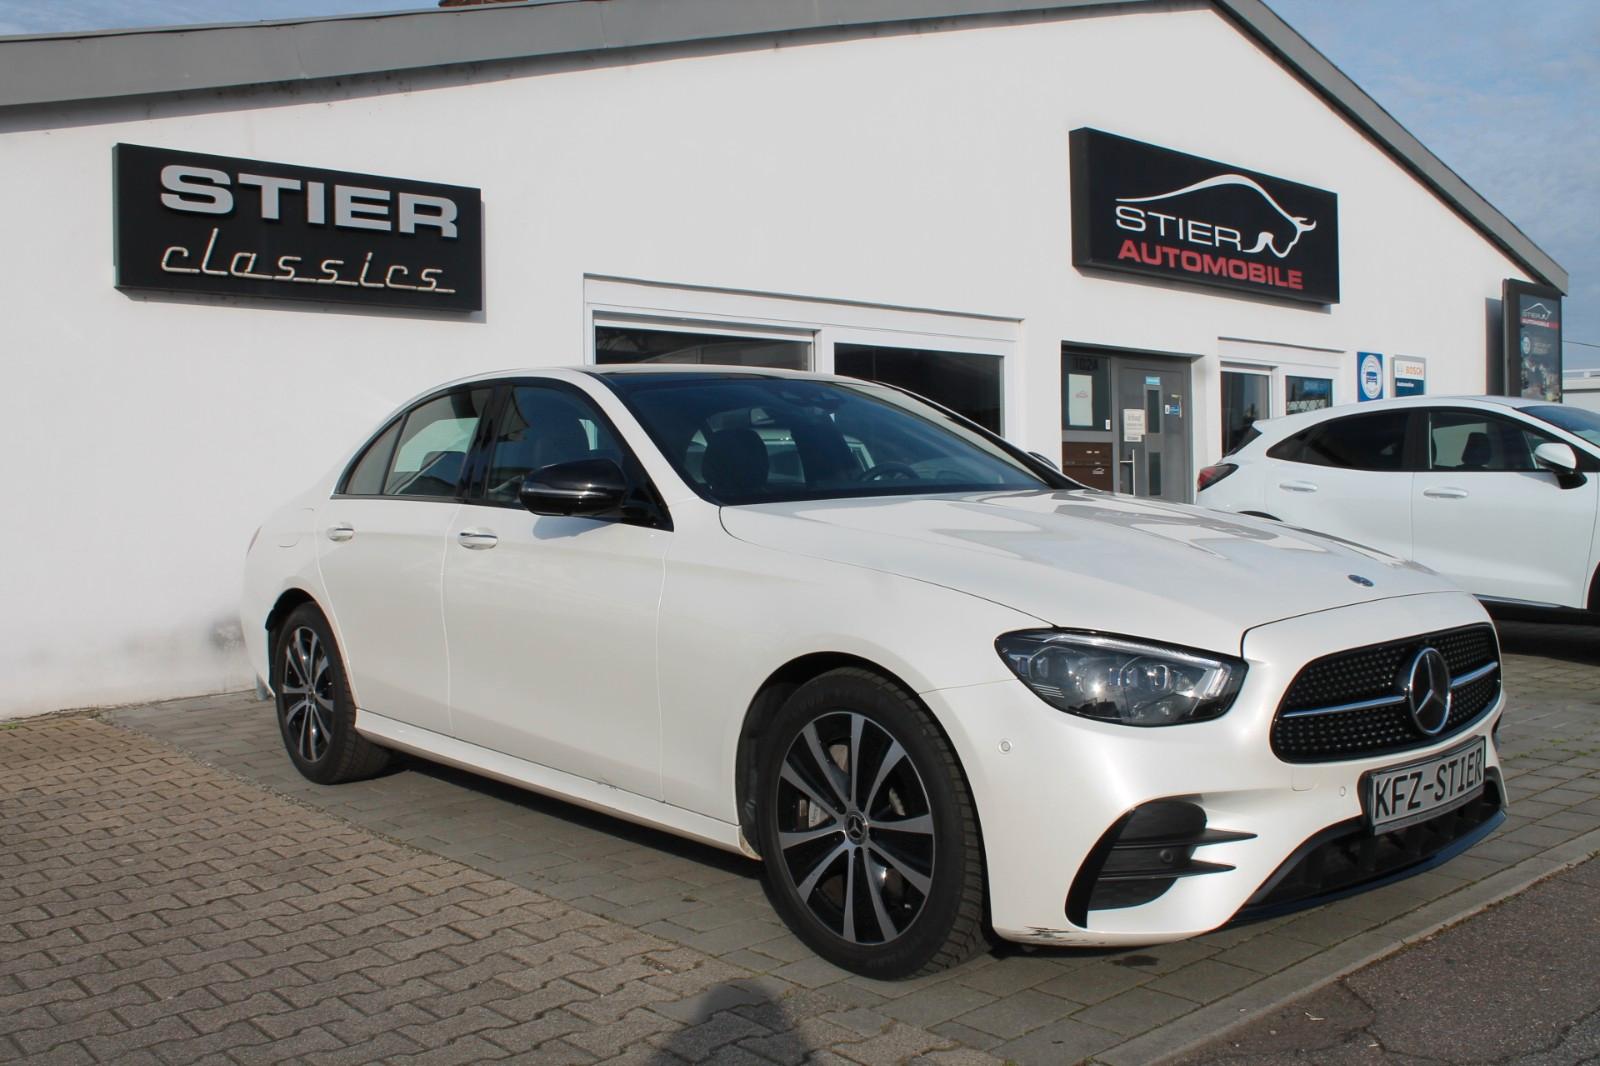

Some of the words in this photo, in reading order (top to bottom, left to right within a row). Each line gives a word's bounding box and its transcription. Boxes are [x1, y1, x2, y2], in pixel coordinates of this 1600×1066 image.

[161, 164, 458, 238] STIER
[1115, 205, 1241, 251] STIER
[161, 227, 456, 293] classics
[1117, 239, 1304, 290] AUTOMOBILE
[1375, 747, 1482, 819] KFZ-STIER
